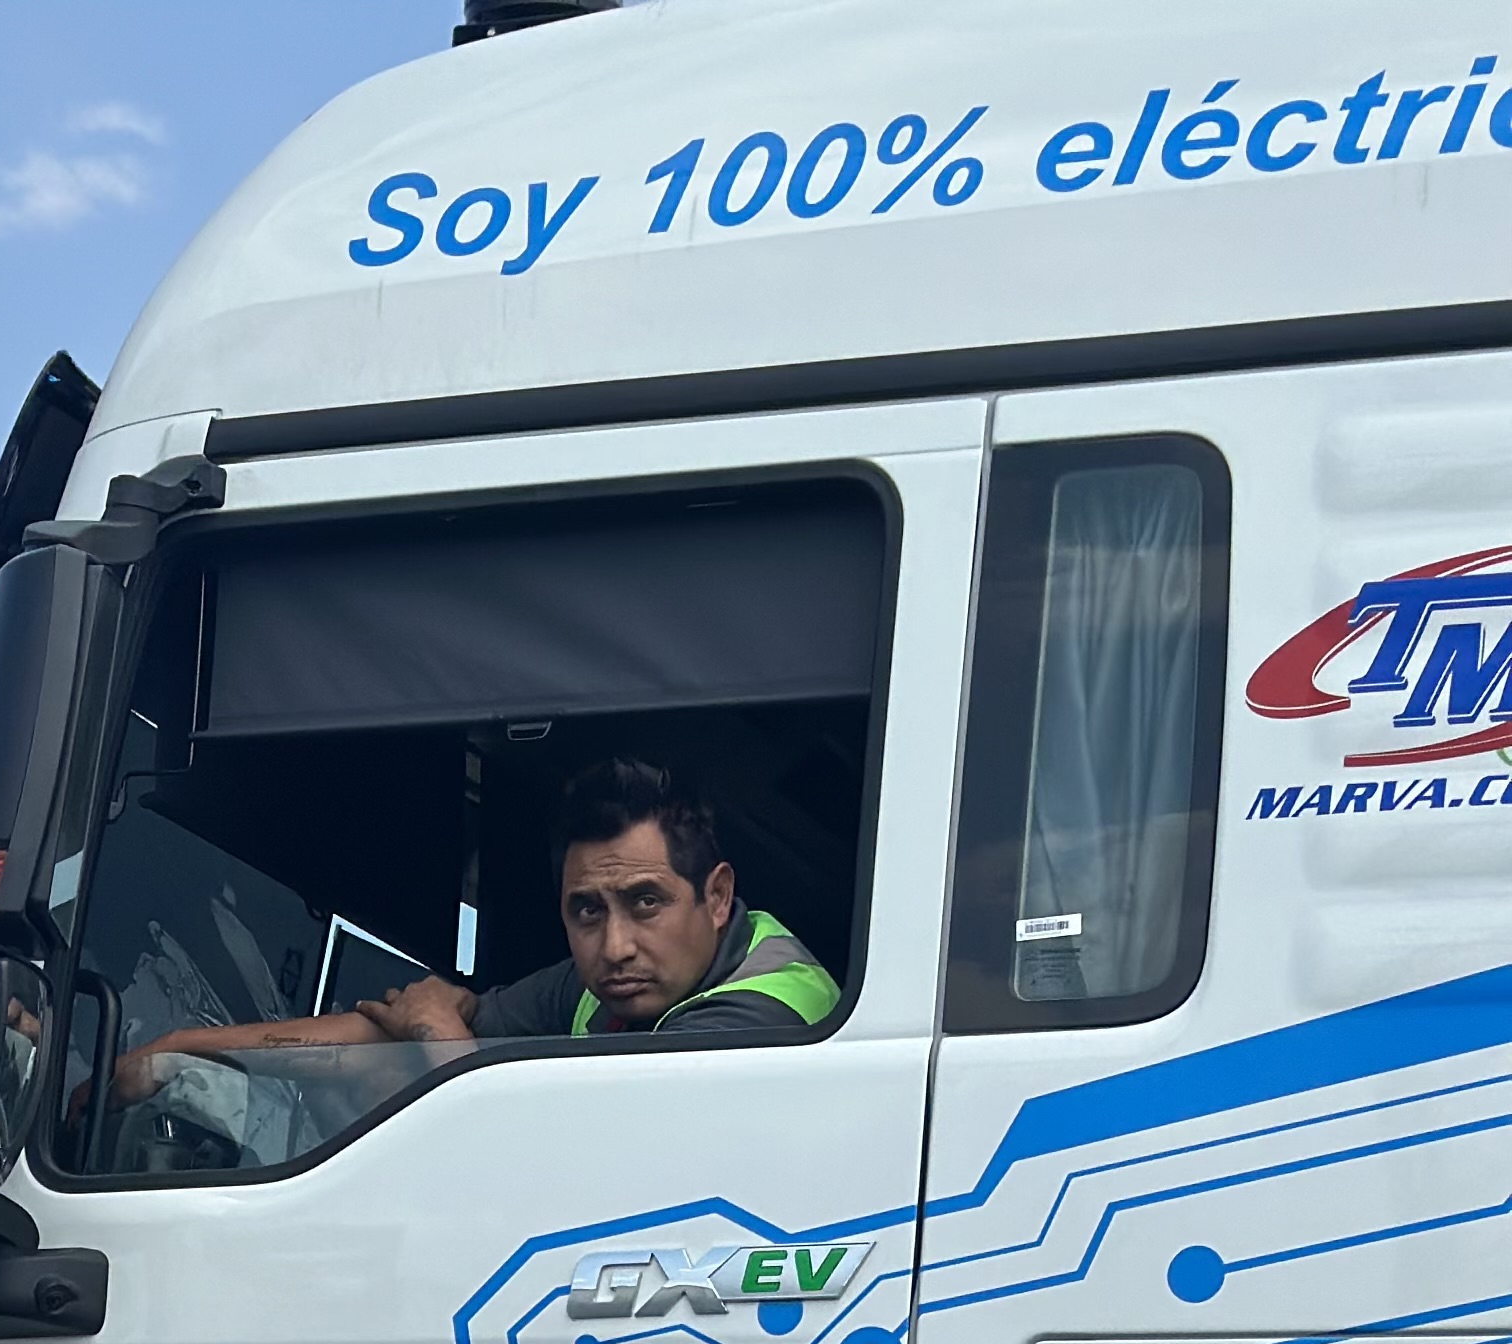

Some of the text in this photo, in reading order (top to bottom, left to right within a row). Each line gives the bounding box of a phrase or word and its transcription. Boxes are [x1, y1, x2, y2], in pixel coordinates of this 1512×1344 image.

[347, 172, 600, 277] Soy
[644, 105, 989, 234] 100%
[1246, 774, 1512, 820] MARVA.C
[567, 1246, 848, 1320] GX EV
